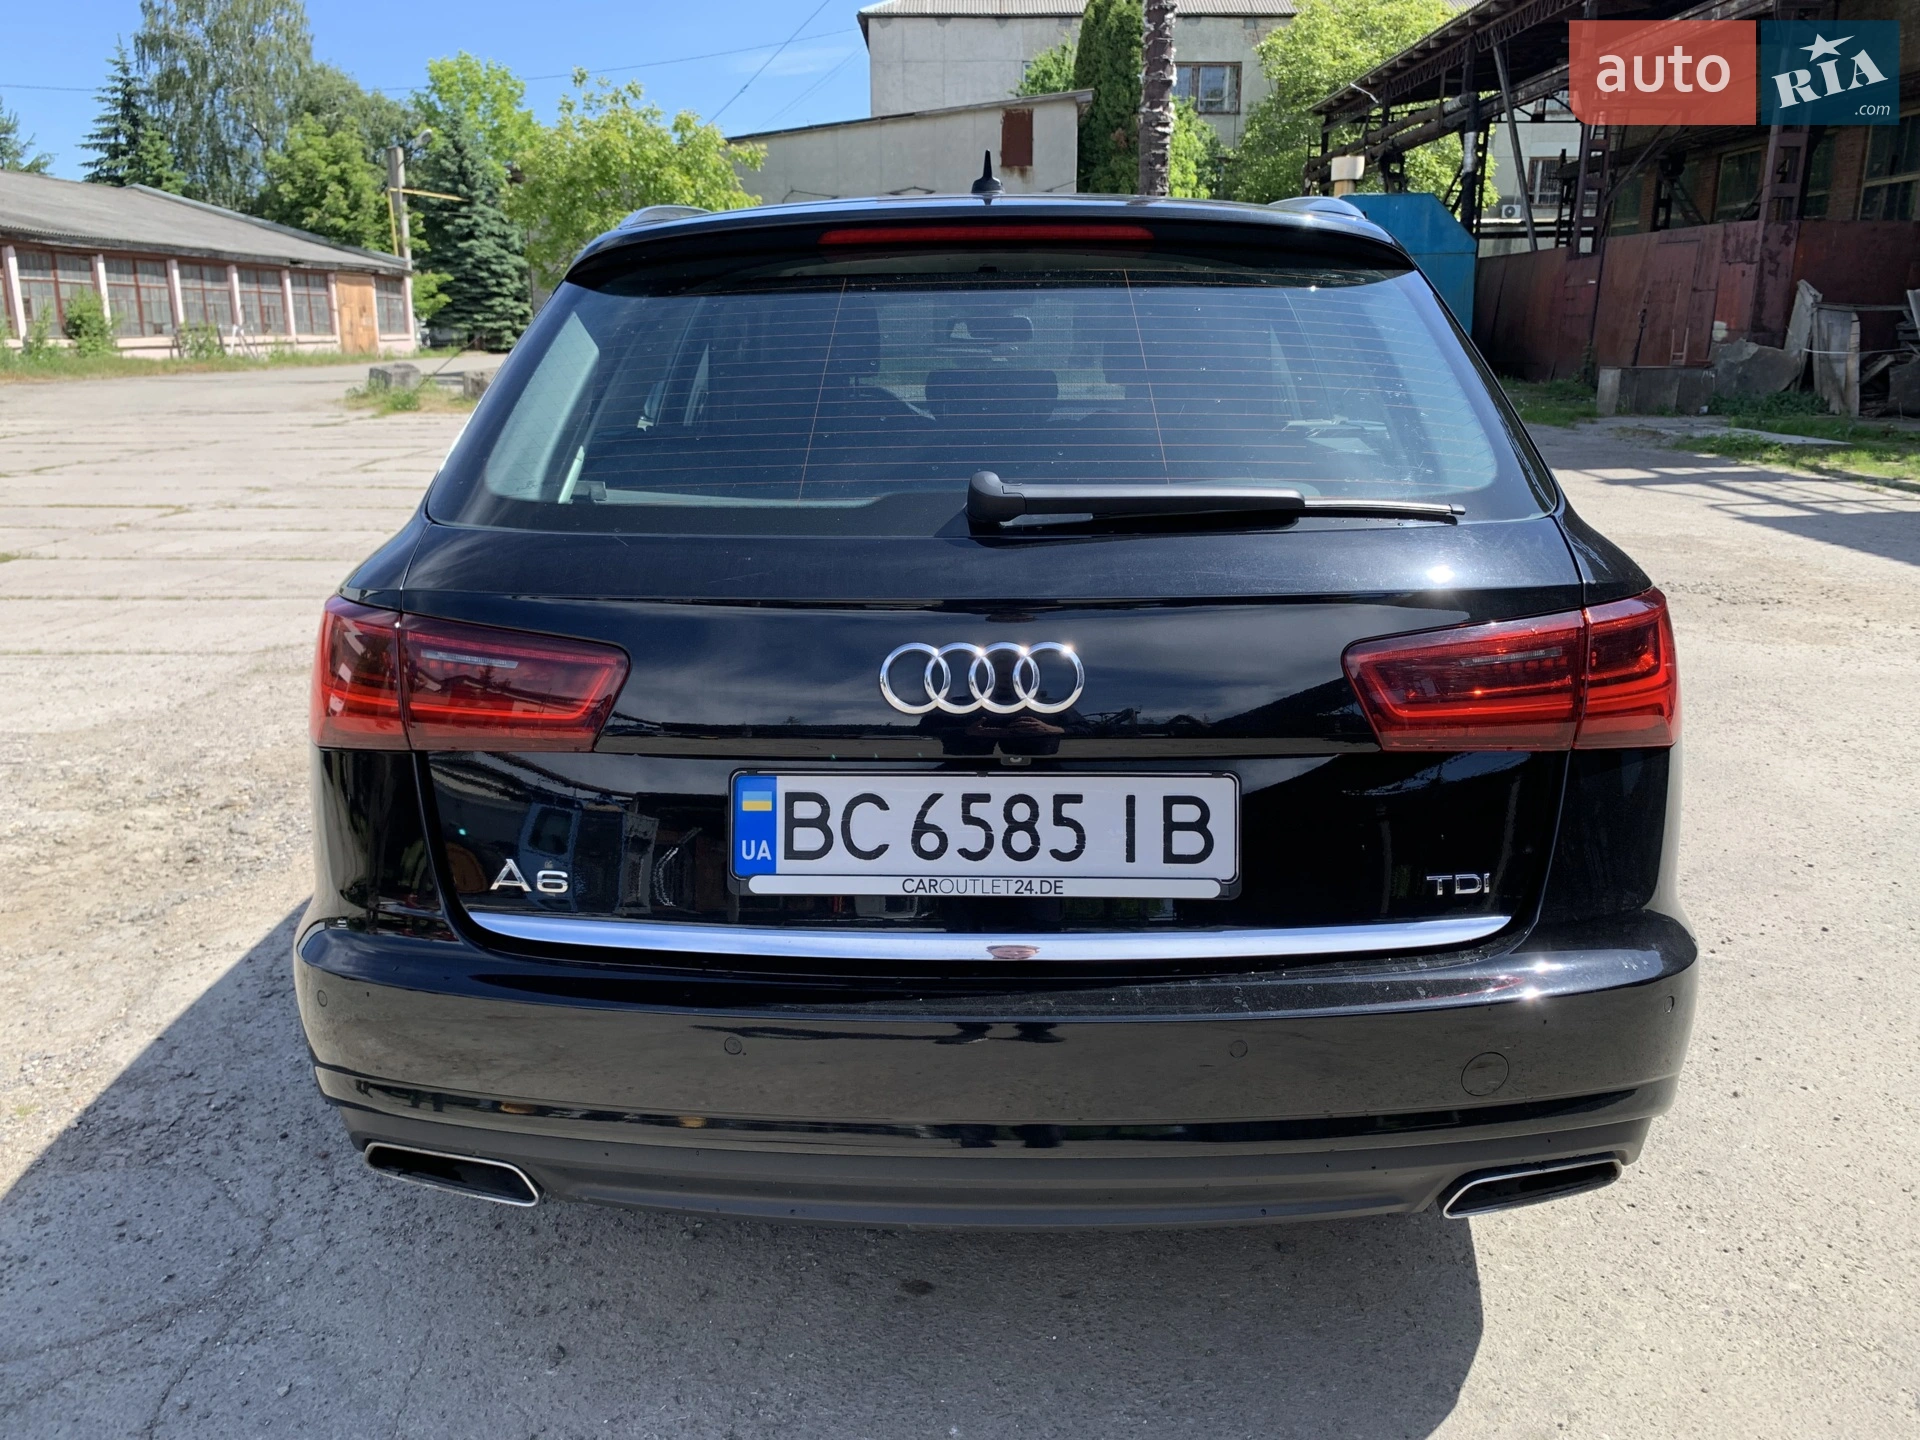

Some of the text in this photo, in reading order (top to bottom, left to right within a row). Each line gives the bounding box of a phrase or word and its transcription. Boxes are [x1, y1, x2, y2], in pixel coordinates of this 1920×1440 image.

[783, 791, 1215, 864] BC 6585 IB
[741, 839, 772, 861] UA
[489, 858, 569, 893] A6
[902, 877, 1064, 895] CAROUTLET24.DE
[1426, 872, 1491, 896] TDI
